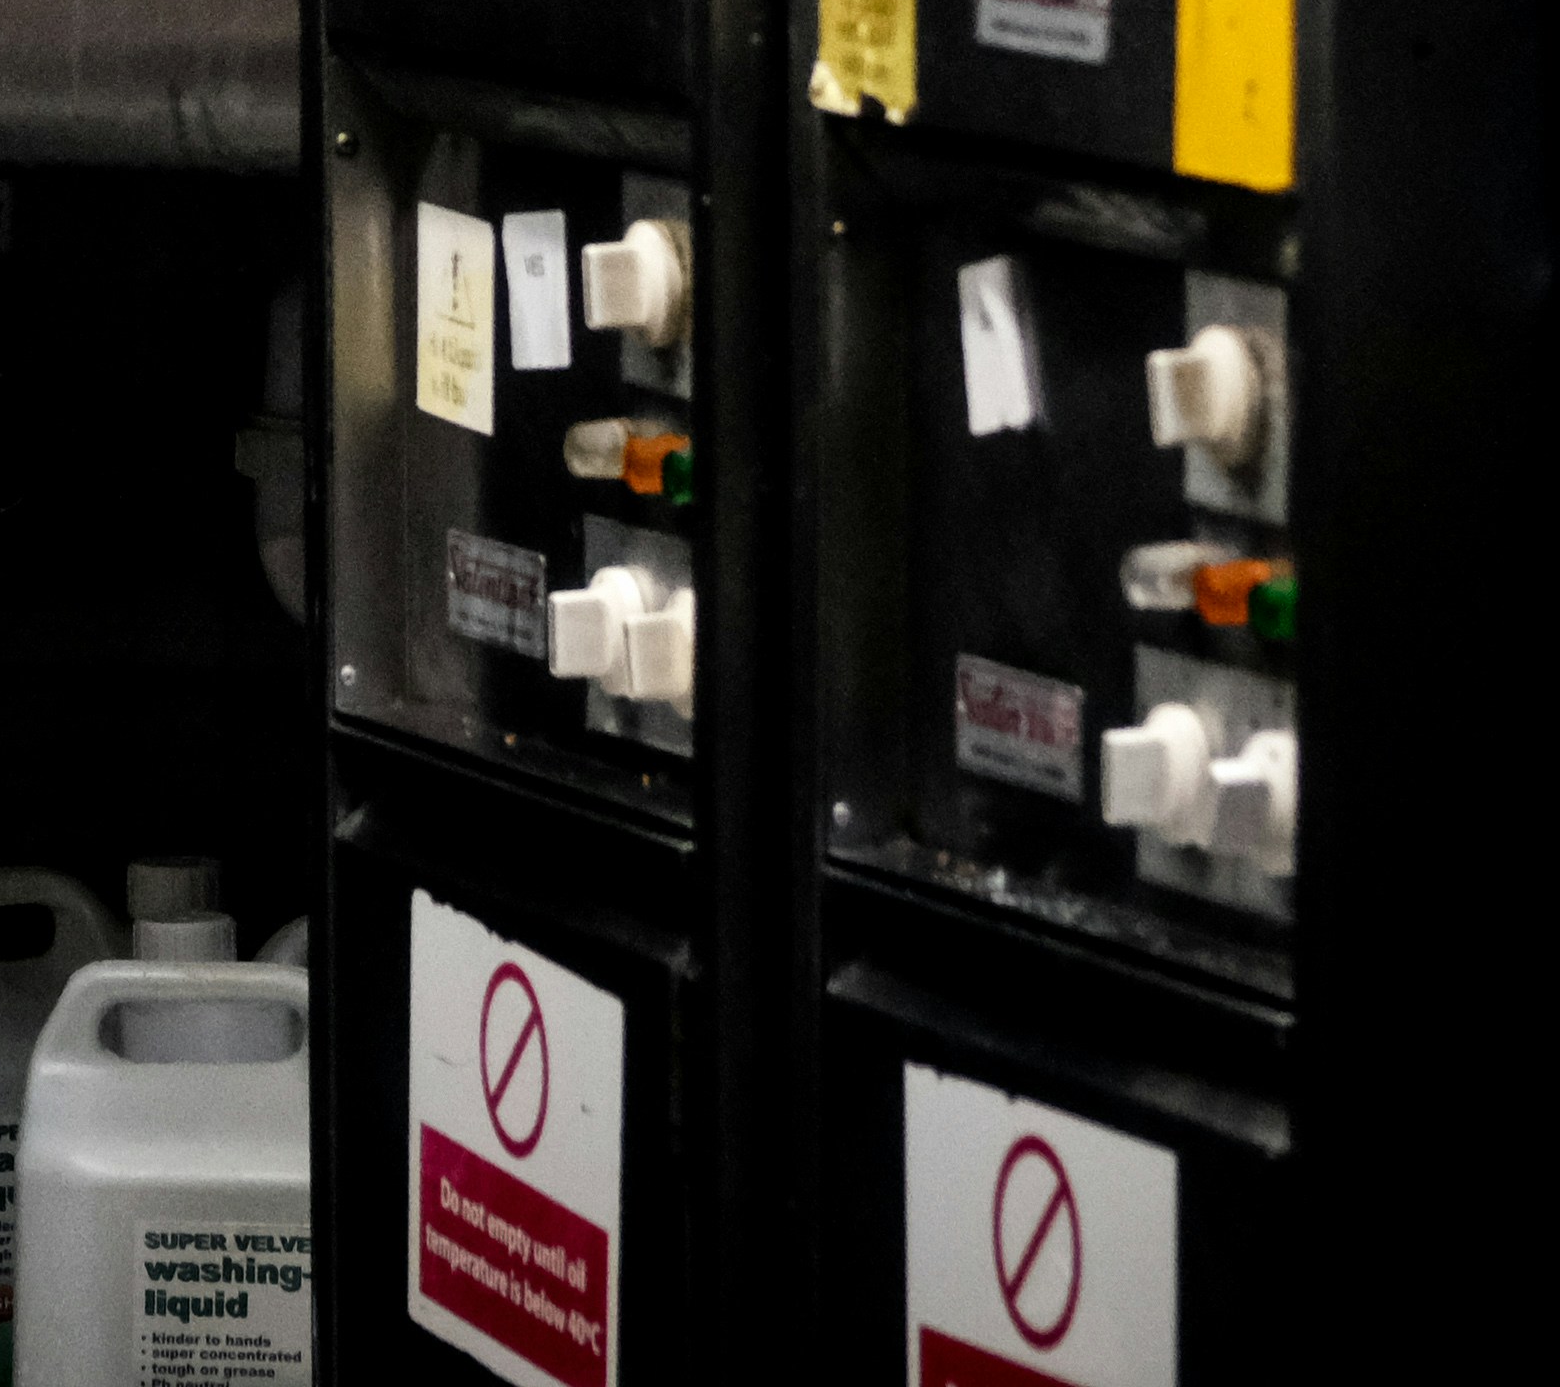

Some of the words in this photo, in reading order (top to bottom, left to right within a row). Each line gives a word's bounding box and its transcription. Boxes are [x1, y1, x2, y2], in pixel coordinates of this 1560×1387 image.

[440, 1176, 460, 1216] Do
[462, 1199, 486, 1232] not
[486, 1214, 532, 1265] empty
[534, 1241, 566, 1281] until
[144, 1231, 227, 1251] SUPER
[425, 1223, 509, 1299] temperature
[510, 1269, 522, 1306] is
[524, 1278, 566, 1333] below
[144, 1289, 249, 1324] liquid
[152, 1333, 200, 1345] kinder
[205, 1334, 221, 1345] to
[225, 1335, 272, 1347] hands
[152, 1349, 195, 1361] super
[199, 1350, 302, 1363] concentrated
[152, 1364, 195, 1377] tough
[200, 1365, 218, 1375] on
[224, 1366, 275, 1378] grease
